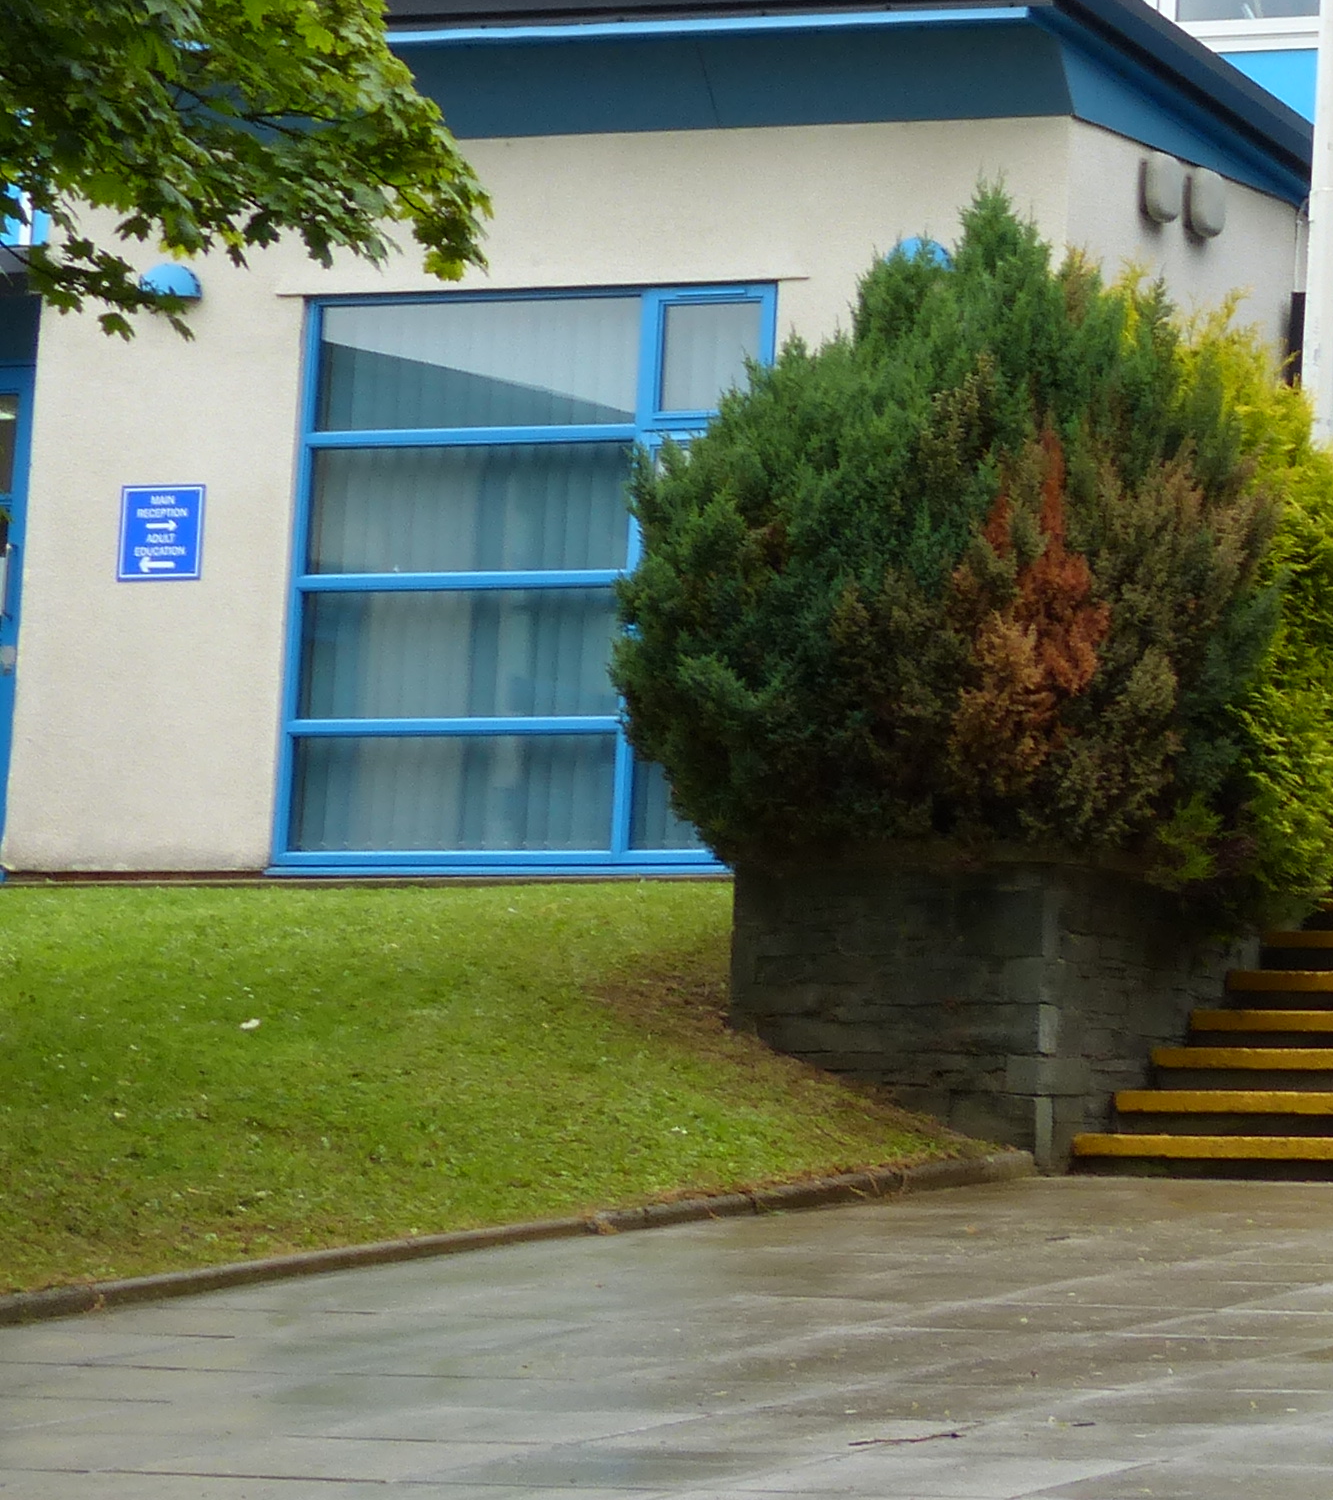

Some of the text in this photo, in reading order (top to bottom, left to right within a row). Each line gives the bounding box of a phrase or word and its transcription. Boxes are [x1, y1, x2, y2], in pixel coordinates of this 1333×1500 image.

[150, 495, 176, 505] MAIN
[136, 507, 189, 518] RECEPTION
[145, 533, 176, 544] ADULT
[133, 546, 187, 557] EDUCATION
